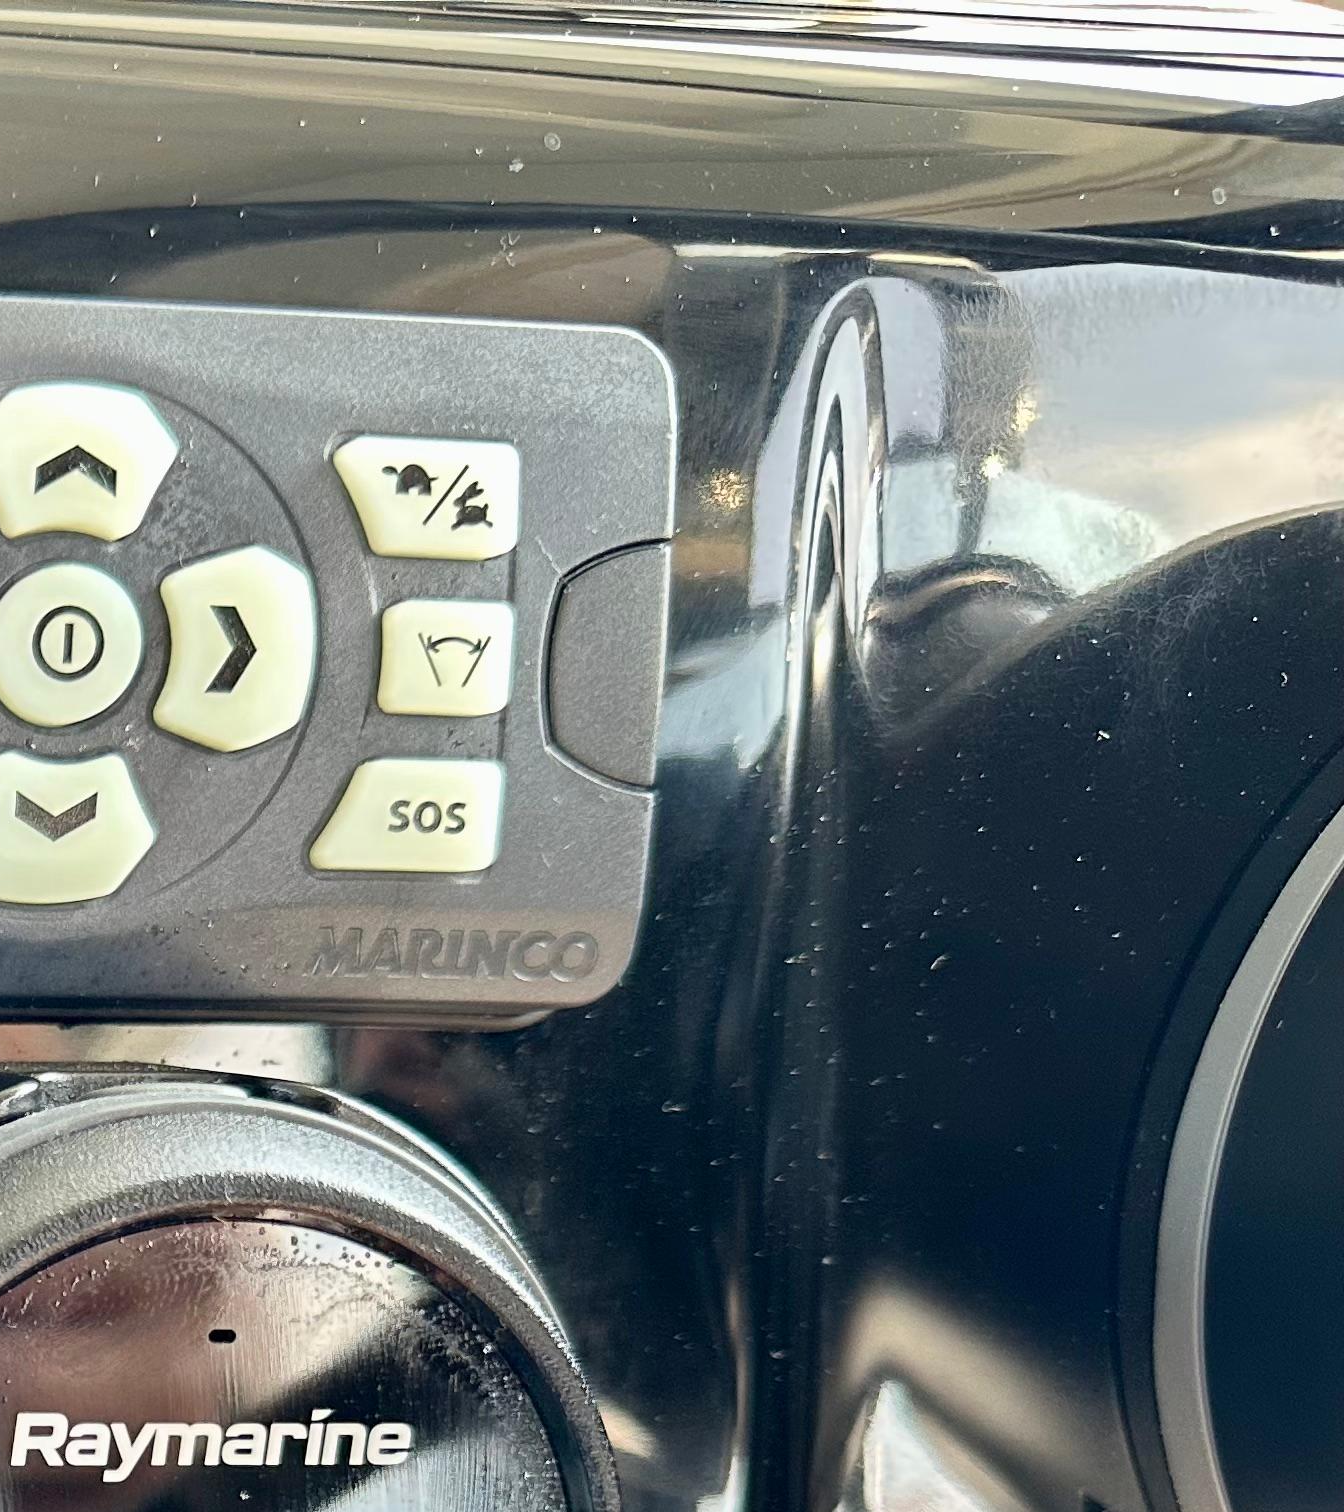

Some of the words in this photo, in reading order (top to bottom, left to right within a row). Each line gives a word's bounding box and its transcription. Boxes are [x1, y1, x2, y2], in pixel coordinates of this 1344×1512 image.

[387, 800, 466, 835] SOS
[311, 926, 599, 982] MARINCO
[11, 1410, 412, 1482] Raymarine
